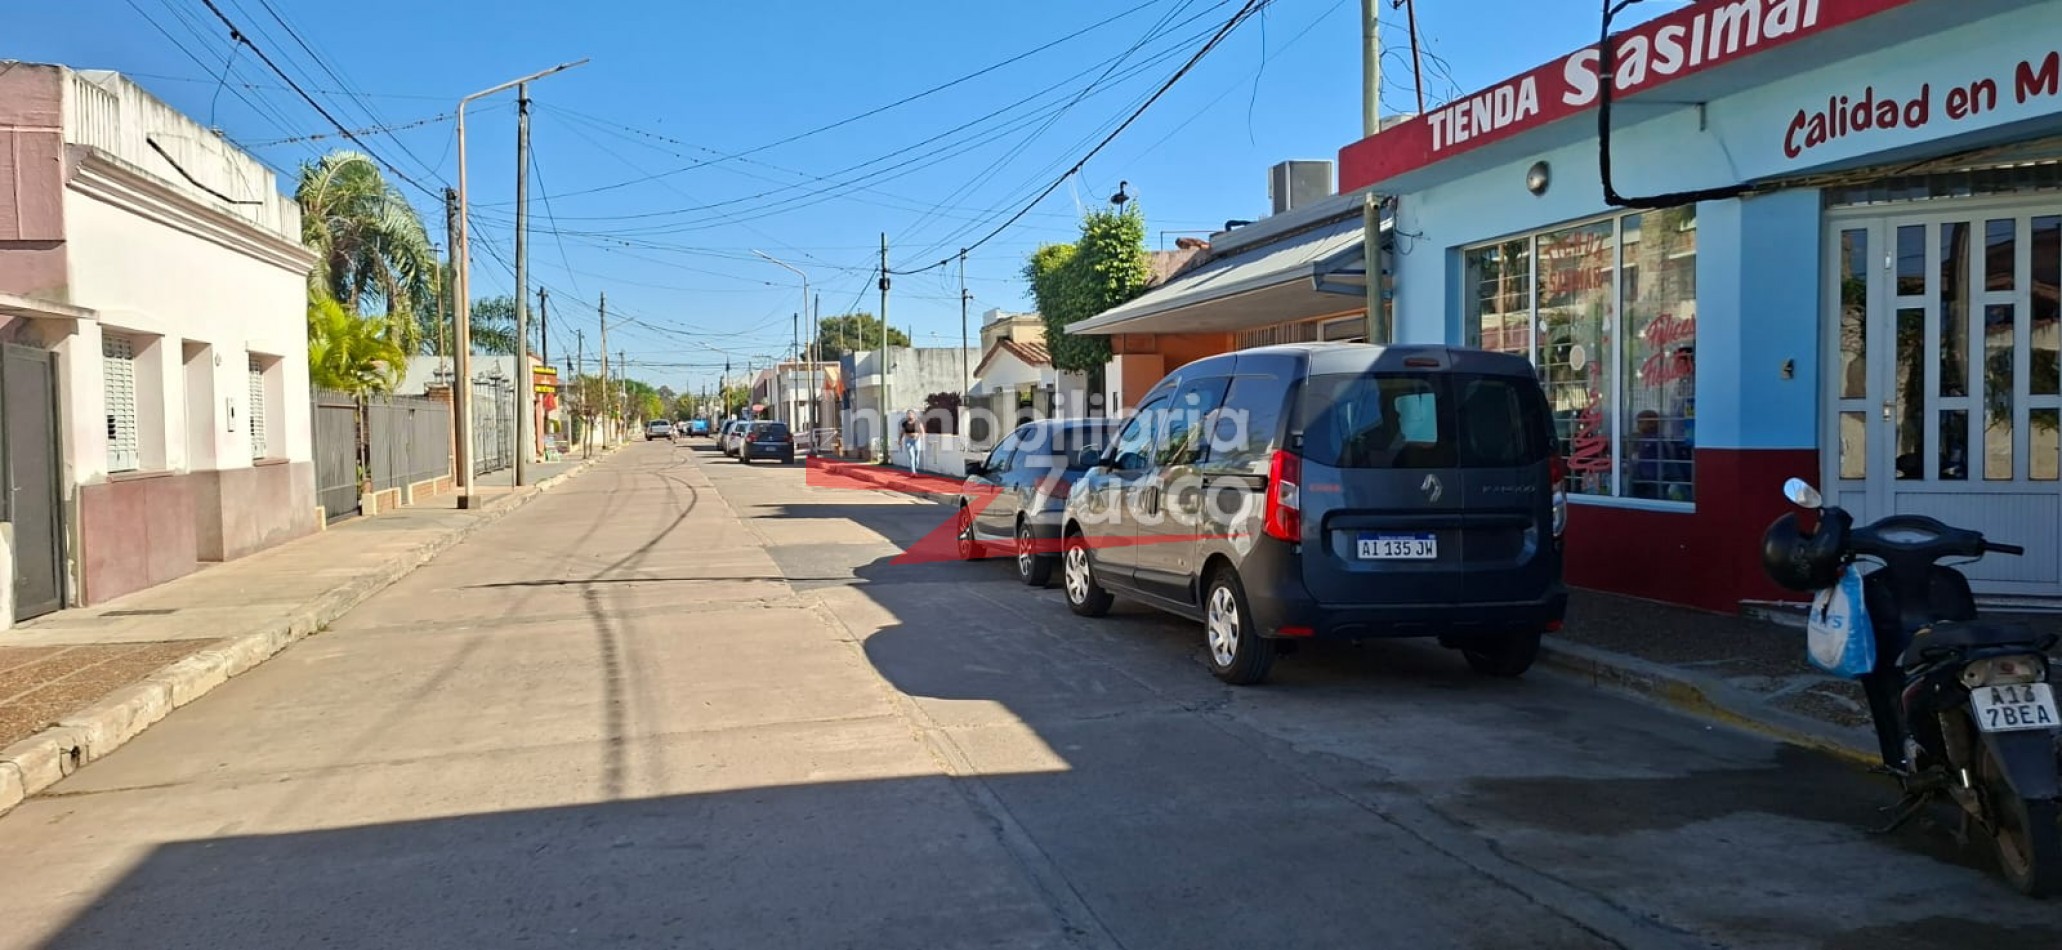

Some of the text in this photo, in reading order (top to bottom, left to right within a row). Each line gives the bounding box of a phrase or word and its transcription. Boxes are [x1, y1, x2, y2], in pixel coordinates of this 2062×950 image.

[1428, 76, 1539, 151] TIENDA
[1784, 83, 1929, 158] Calidad
[1946, 78, 1997, 119] en
[1361, 541, 1433, 556] AI 135 JW
[1986, 704, 2051, 727] 7BEA
